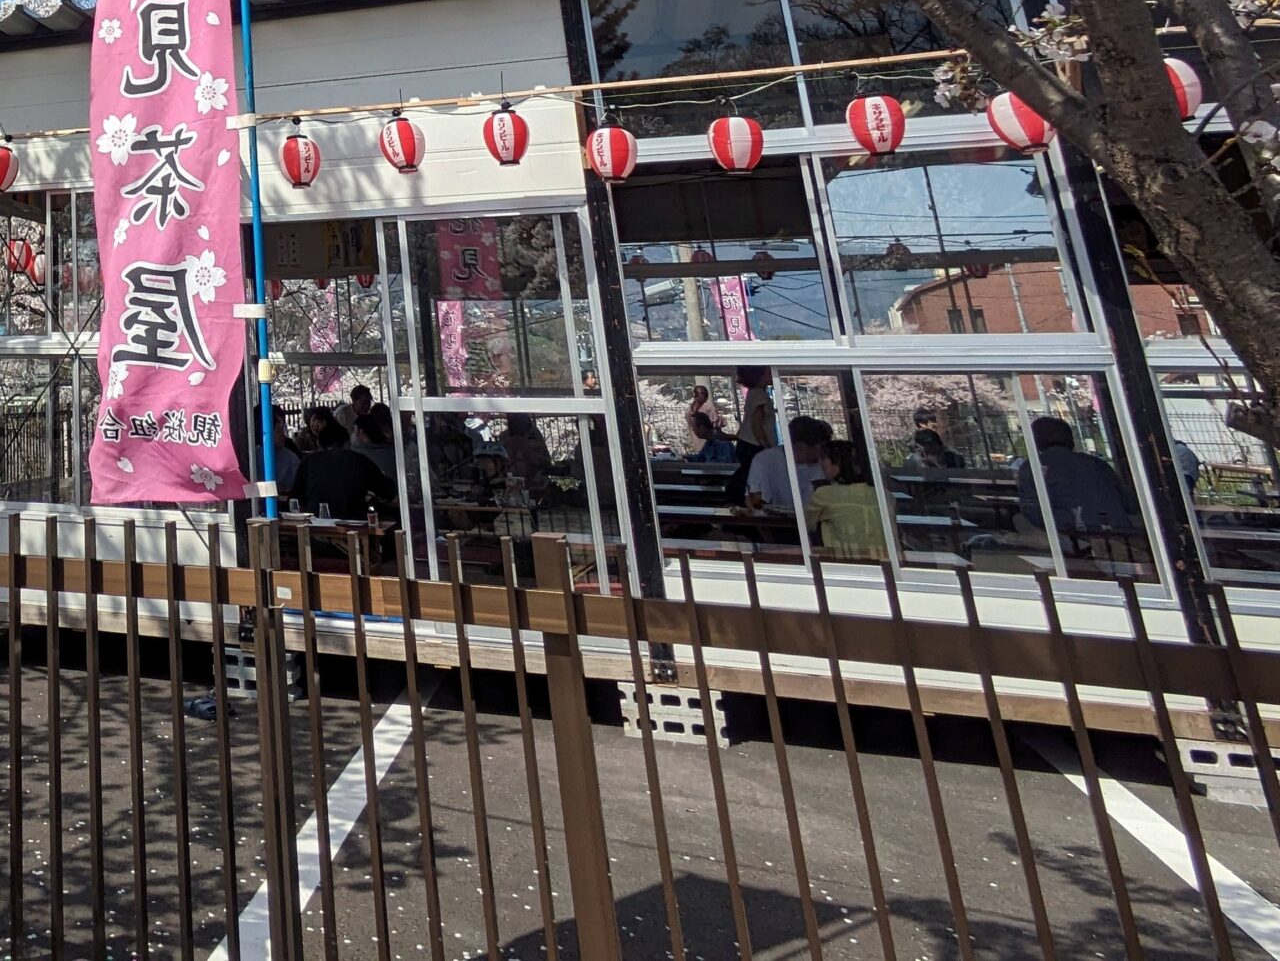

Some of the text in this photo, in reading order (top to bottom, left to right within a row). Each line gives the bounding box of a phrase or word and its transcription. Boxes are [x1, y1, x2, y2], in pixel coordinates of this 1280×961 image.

[871, 103, 889, 143] キリンビール
[596, 132, 608, 167] キリンビール
